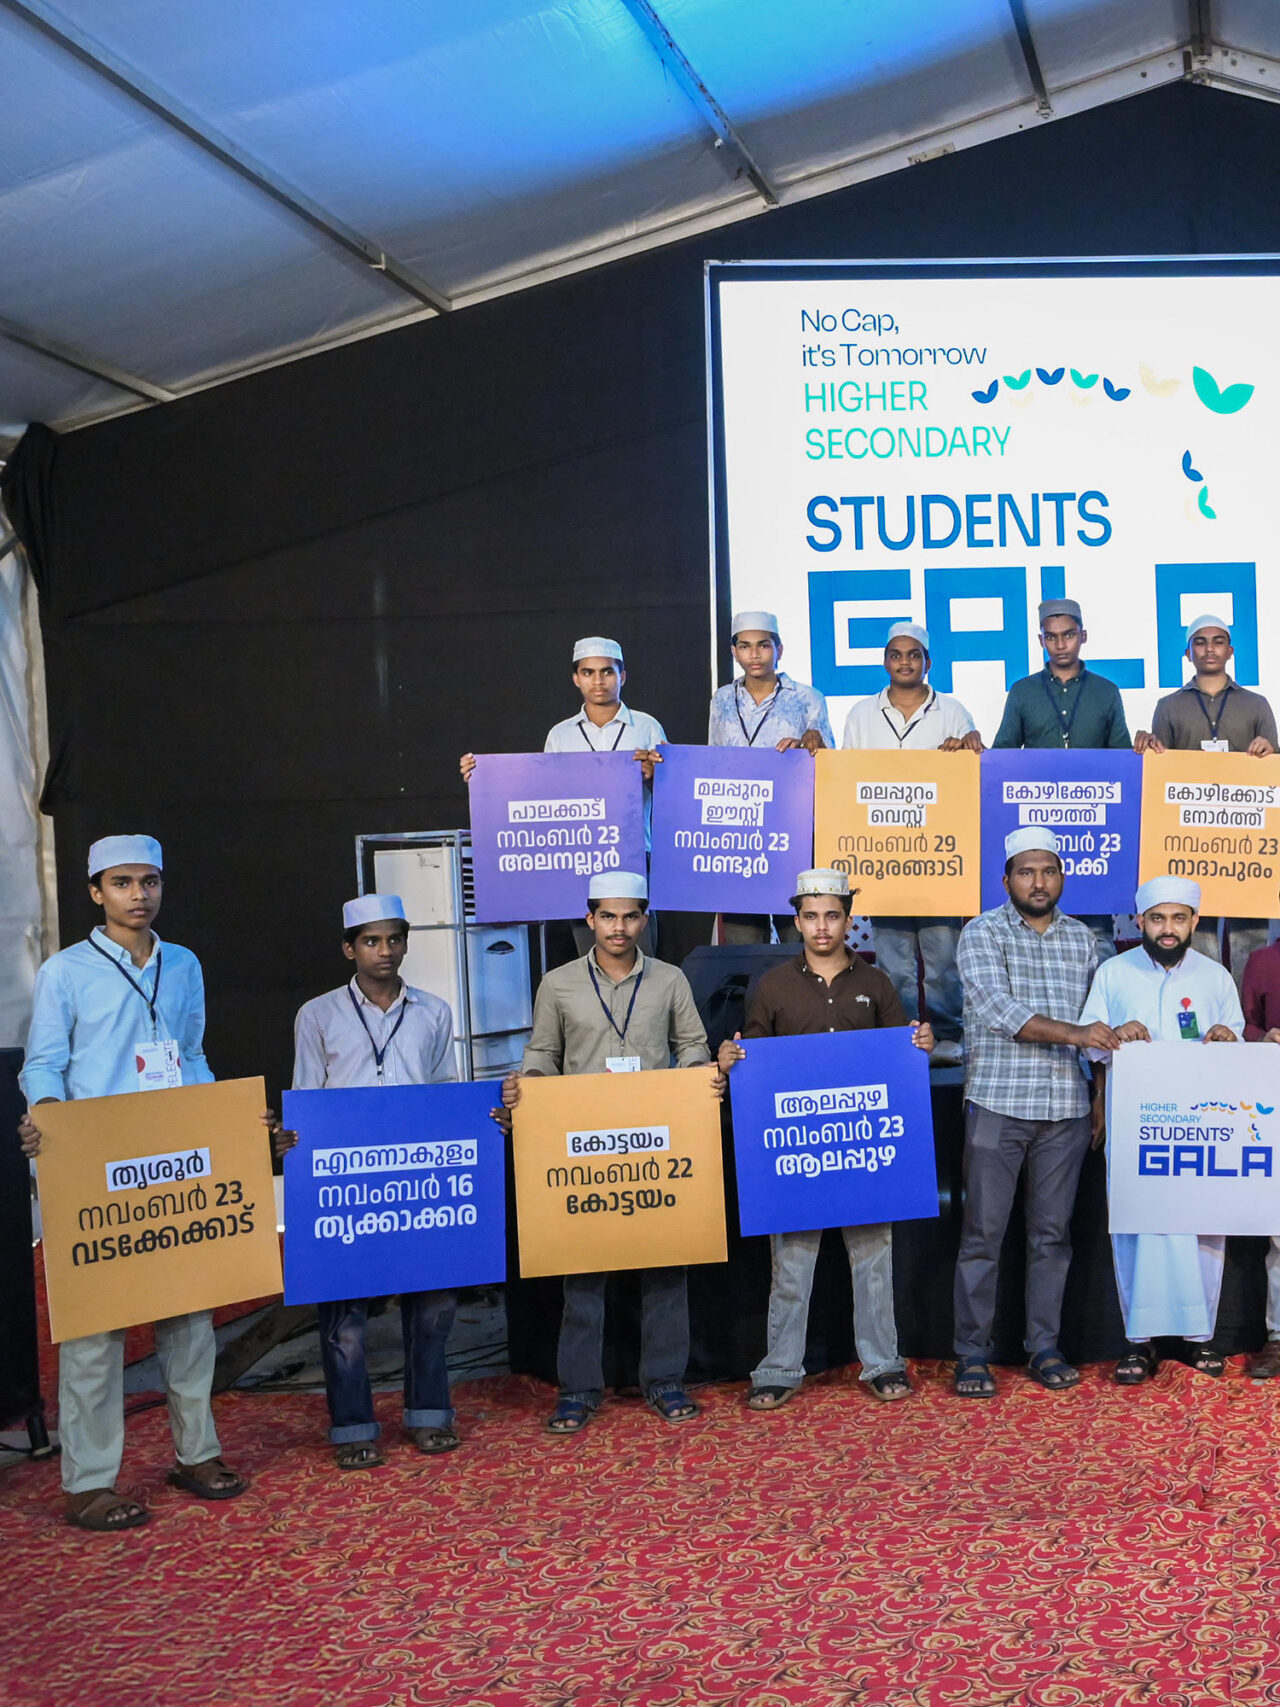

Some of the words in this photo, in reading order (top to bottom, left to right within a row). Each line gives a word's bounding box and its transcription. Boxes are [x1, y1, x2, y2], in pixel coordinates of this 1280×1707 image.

[801, 309, 837, 332] No
[841, 309, 899, 335] Cap,
[803, 344, 835, 367] it's
[840, 344, 987, 366] Tomorrow
[805, 381, 928, 413] HIGHER
[805, 426, 1011, 460] SECONDARY
[805, 491, 1112, 552] STUDENTS
[698, 781, 770, 801] മലപ്പുറം
[860, 784, 933, 803] മലപ്പുറം
[1006, 780, 1115, 800] കോഴിക്കോട്
[1168, 784, 1275, 804] കോഴിക്കോട്
[513, 798, 602, 820] പാലക്കാട്
[1183, 808, 1263, 826] നോർത്ത്
[497, 826, 592, 849] നവംബർ
[598, 826, 620, 845] 23
[674, 830, 763, 851] നവംബർ
[768, 833, 790, 852] 23
[838, 833, 928, 852] നവംബർ
[934, 835, 956, 852] 29
[1099, 833, 1121, 852] 23
[1164, 834, 1252, 854] നവംബർ
[1258, 838, 1278, 855] 23
[499, 847, 620, 875] അലനല്ലൂർ
[692, 852, 769, 878] വണ്ടൂർ
[1168, 859, 1273, 881] നാദാപുരം
[781, 1088, 881, 1115] ആലപ്പുഴ
[1140, 1103, 1177, 1112] HIGHER
[1140, 1114, 1201, 1123] SECONDARY
[572, 1131, 664, 1154] കോട്ടയം
[763, 1119, 872, 1149] നവംബർ
[878, 1116, 905, 1138] 23
[112, 1151, 204, 1189] തൃശൂർ
[314, 1144, 474, 1174] എറണാകുളം
[775, 1145, 896, 1176] ആലപ്പുഴ
[1139, 1144, 1272, 1177] GALA
[547, 1157, 659, 1188] നവംബർ
[668, 1158, 693, 1179] 22
[319, 1173, 440, 1208] നവംബർ
[447, 1174, 473, 1197] 16
[566, 1189, 676, 1216] കോട്ടയം
[79, 1184, 206, 1231] നവംബർ
[215, 1181, 243, 1206] 23
[72, 1203, 255, 1266] വടക്കേക്കാട്
[314, 1203, 477, 1245] തൃക്കാക്കര
